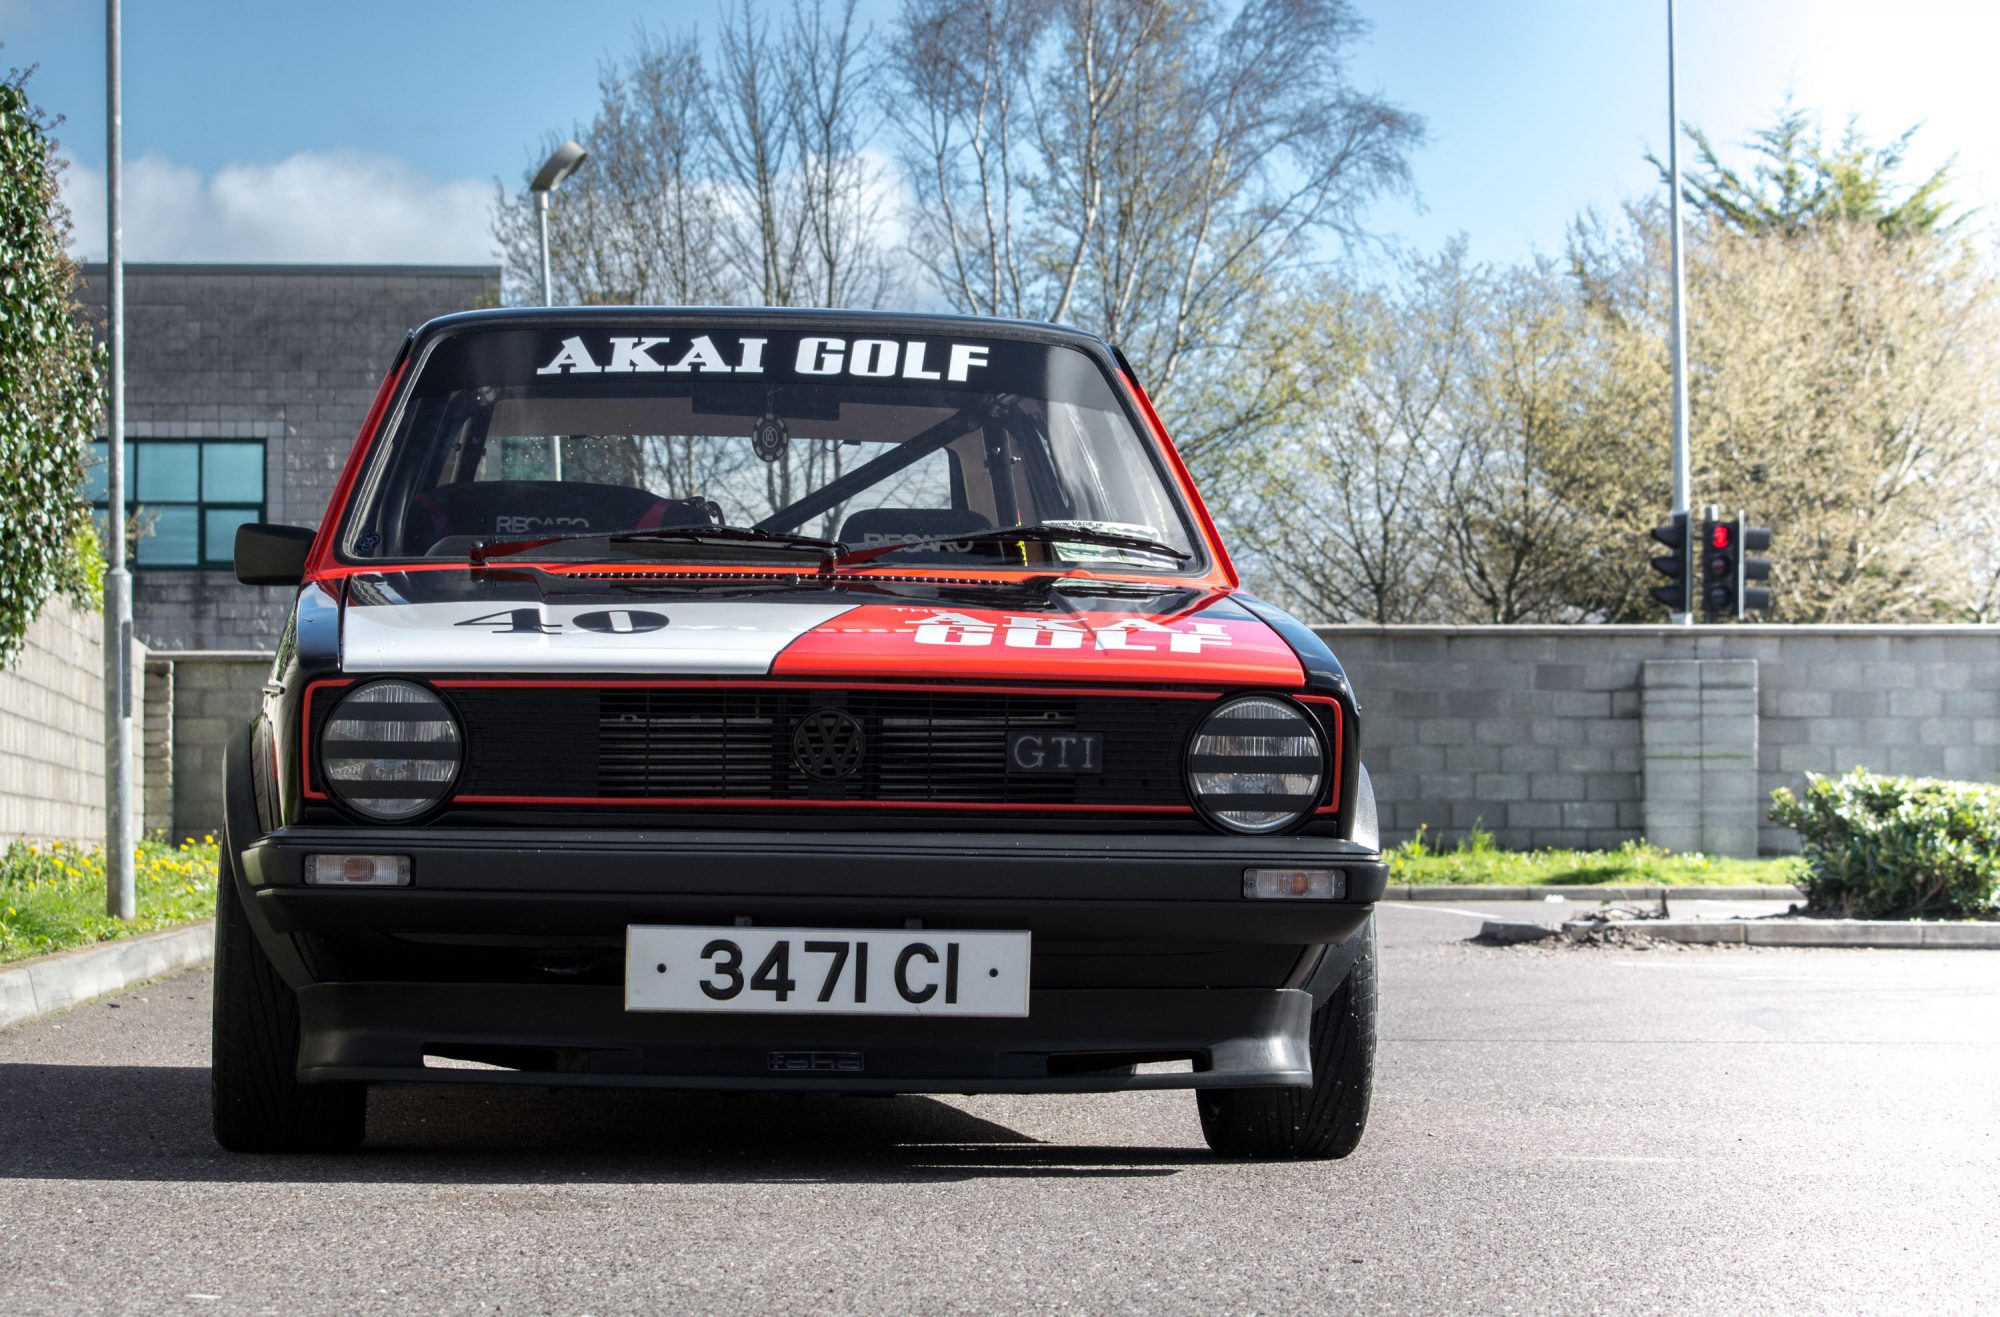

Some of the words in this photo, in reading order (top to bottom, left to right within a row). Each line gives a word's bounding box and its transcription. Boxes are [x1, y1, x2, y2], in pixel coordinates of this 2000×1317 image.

[537, 335, 768, 375] AKAI
[794, 337, 990, 382] GOLF
[453, 608, 670, 634] 40
[904, 611, 1230, 637] AKAI
[914, 624, 1233, 654] GOLF
[1013, 735, 1095, 769] GTI
[699, 938, 869, 1003] 3471
[894, 942, 959, 1005] CI
